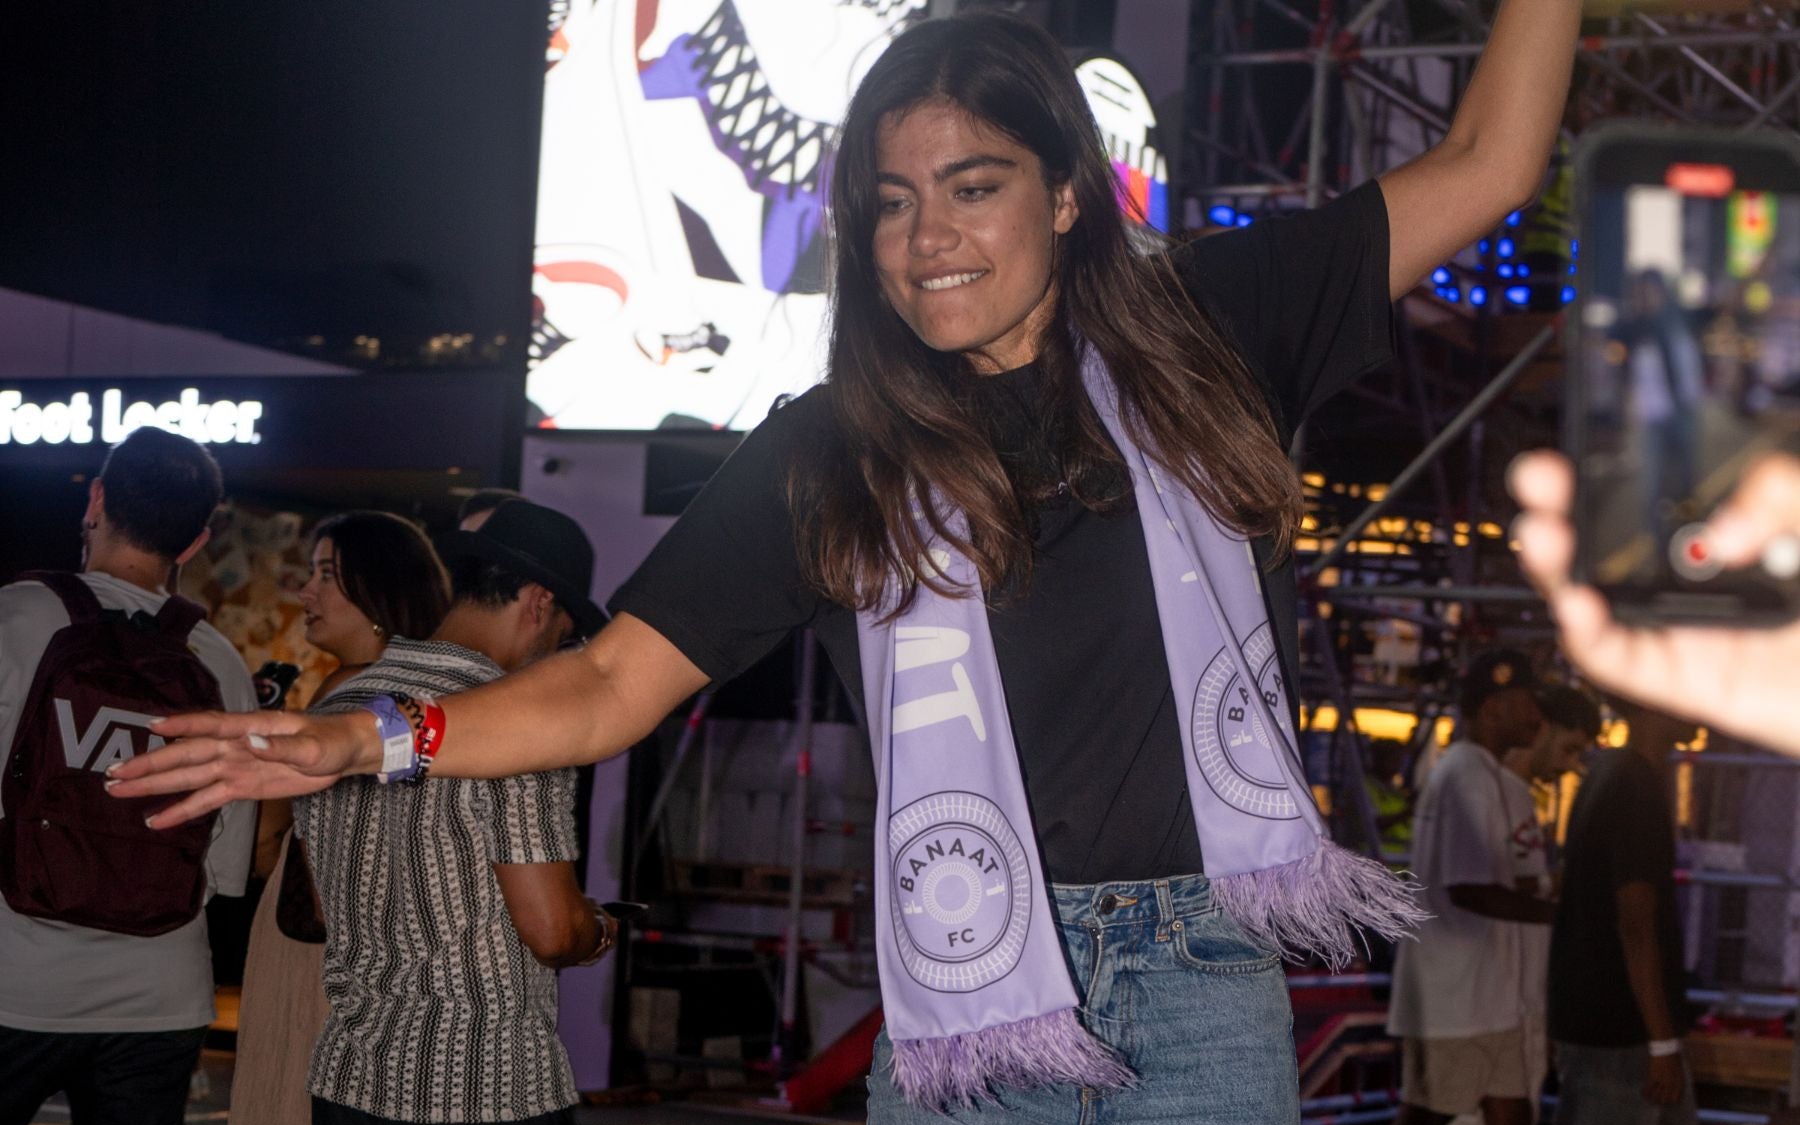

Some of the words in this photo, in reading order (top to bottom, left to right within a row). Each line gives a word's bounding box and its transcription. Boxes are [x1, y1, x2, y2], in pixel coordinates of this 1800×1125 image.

[54, 698, 168, 773] VA
[900, 838, 999, 892] BANAAT
[947, 928, 975, 947] FC
